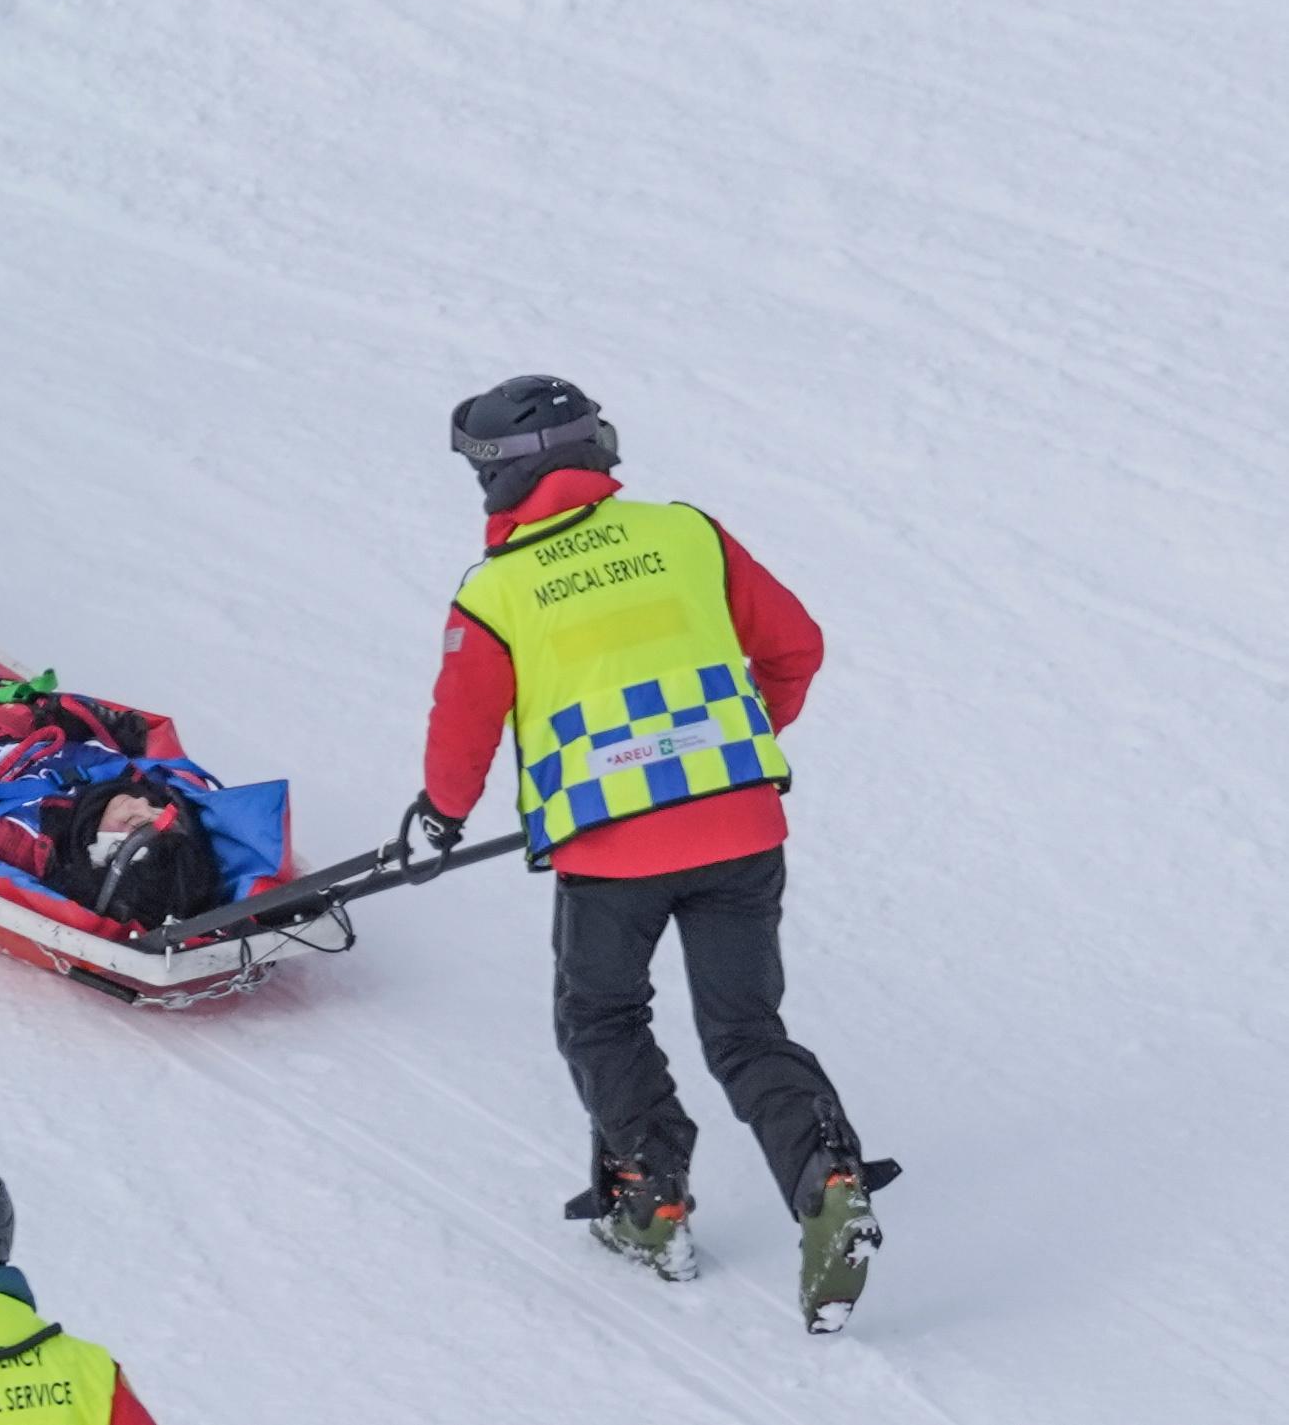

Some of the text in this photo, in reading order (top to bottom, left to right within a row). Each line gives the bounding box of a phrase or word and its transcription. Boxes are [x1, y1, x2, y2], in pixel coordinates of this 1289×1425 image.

[534, 523, 629, 566] EMERGENCY
[534, 551, 666, 609] MEDICAL SERVICE
[5, 1381, 72, 1410] SERVICE
